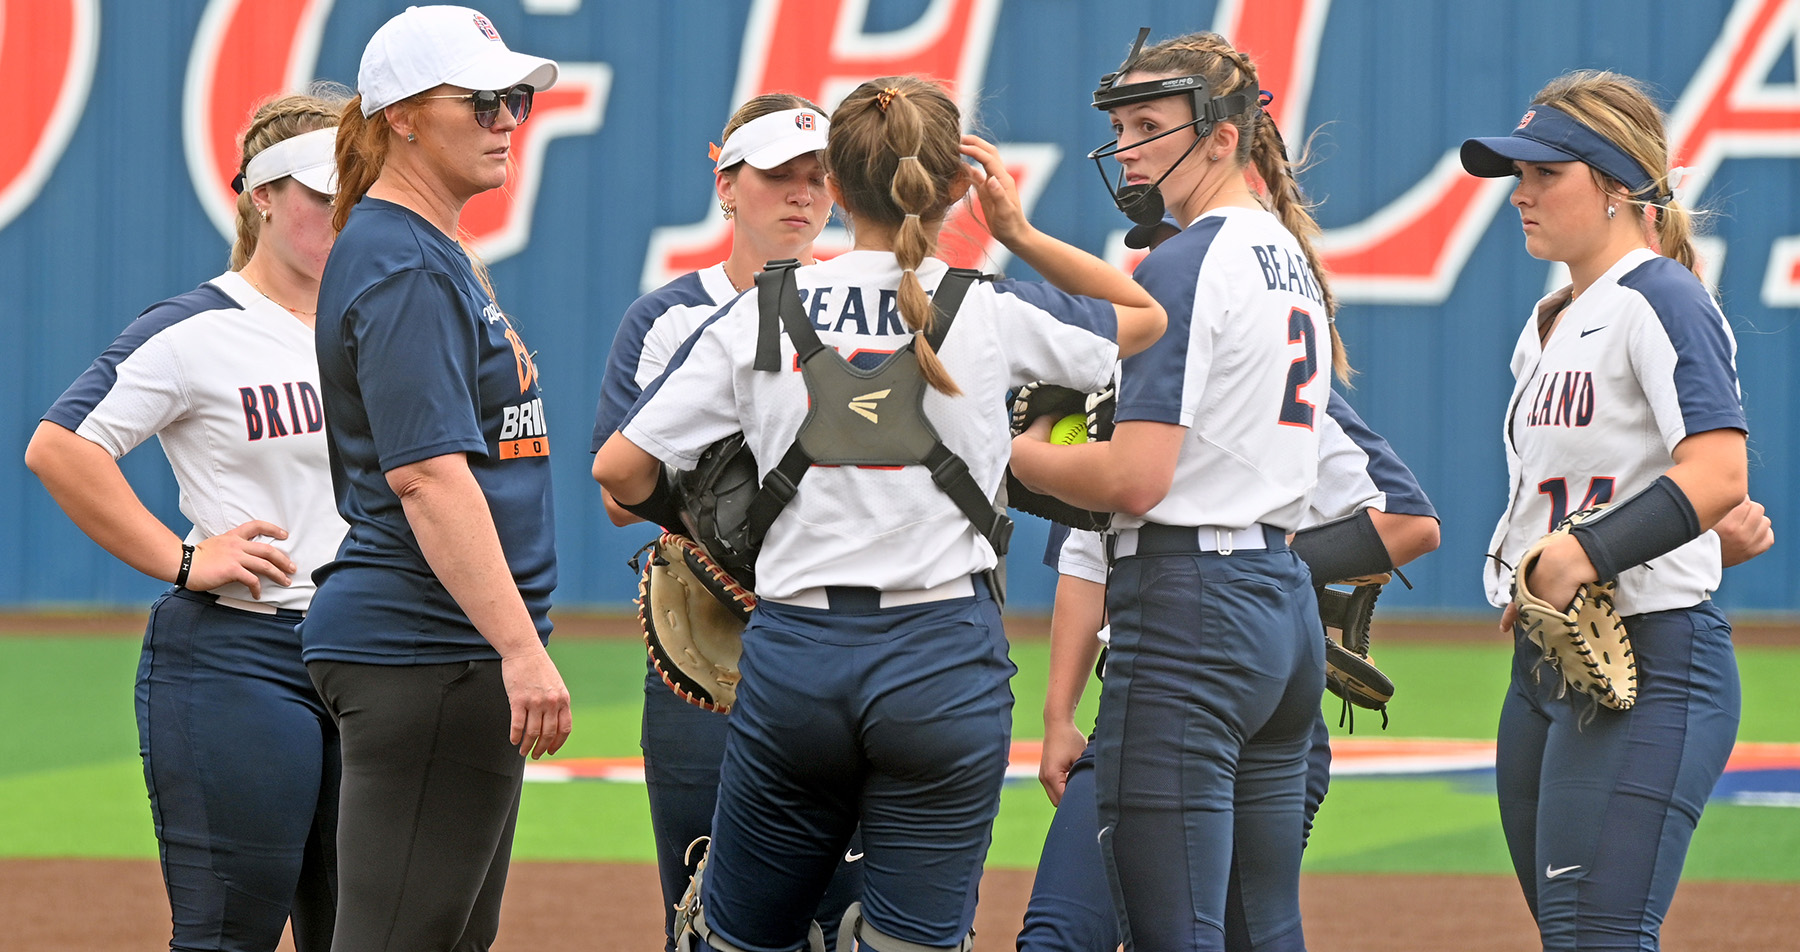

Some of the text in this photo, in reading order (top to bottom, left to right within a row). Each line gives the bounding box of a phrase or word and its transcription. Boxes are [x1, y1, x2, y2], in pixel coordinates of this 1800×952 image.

[788, 286, 934, 337] EAR
[1277, 305, 1318, 432] 2
[238, 381, 324, 442] BRID
[499, 397, 548, 440] BRI
[1526, 370, 1595, 429] LAND
